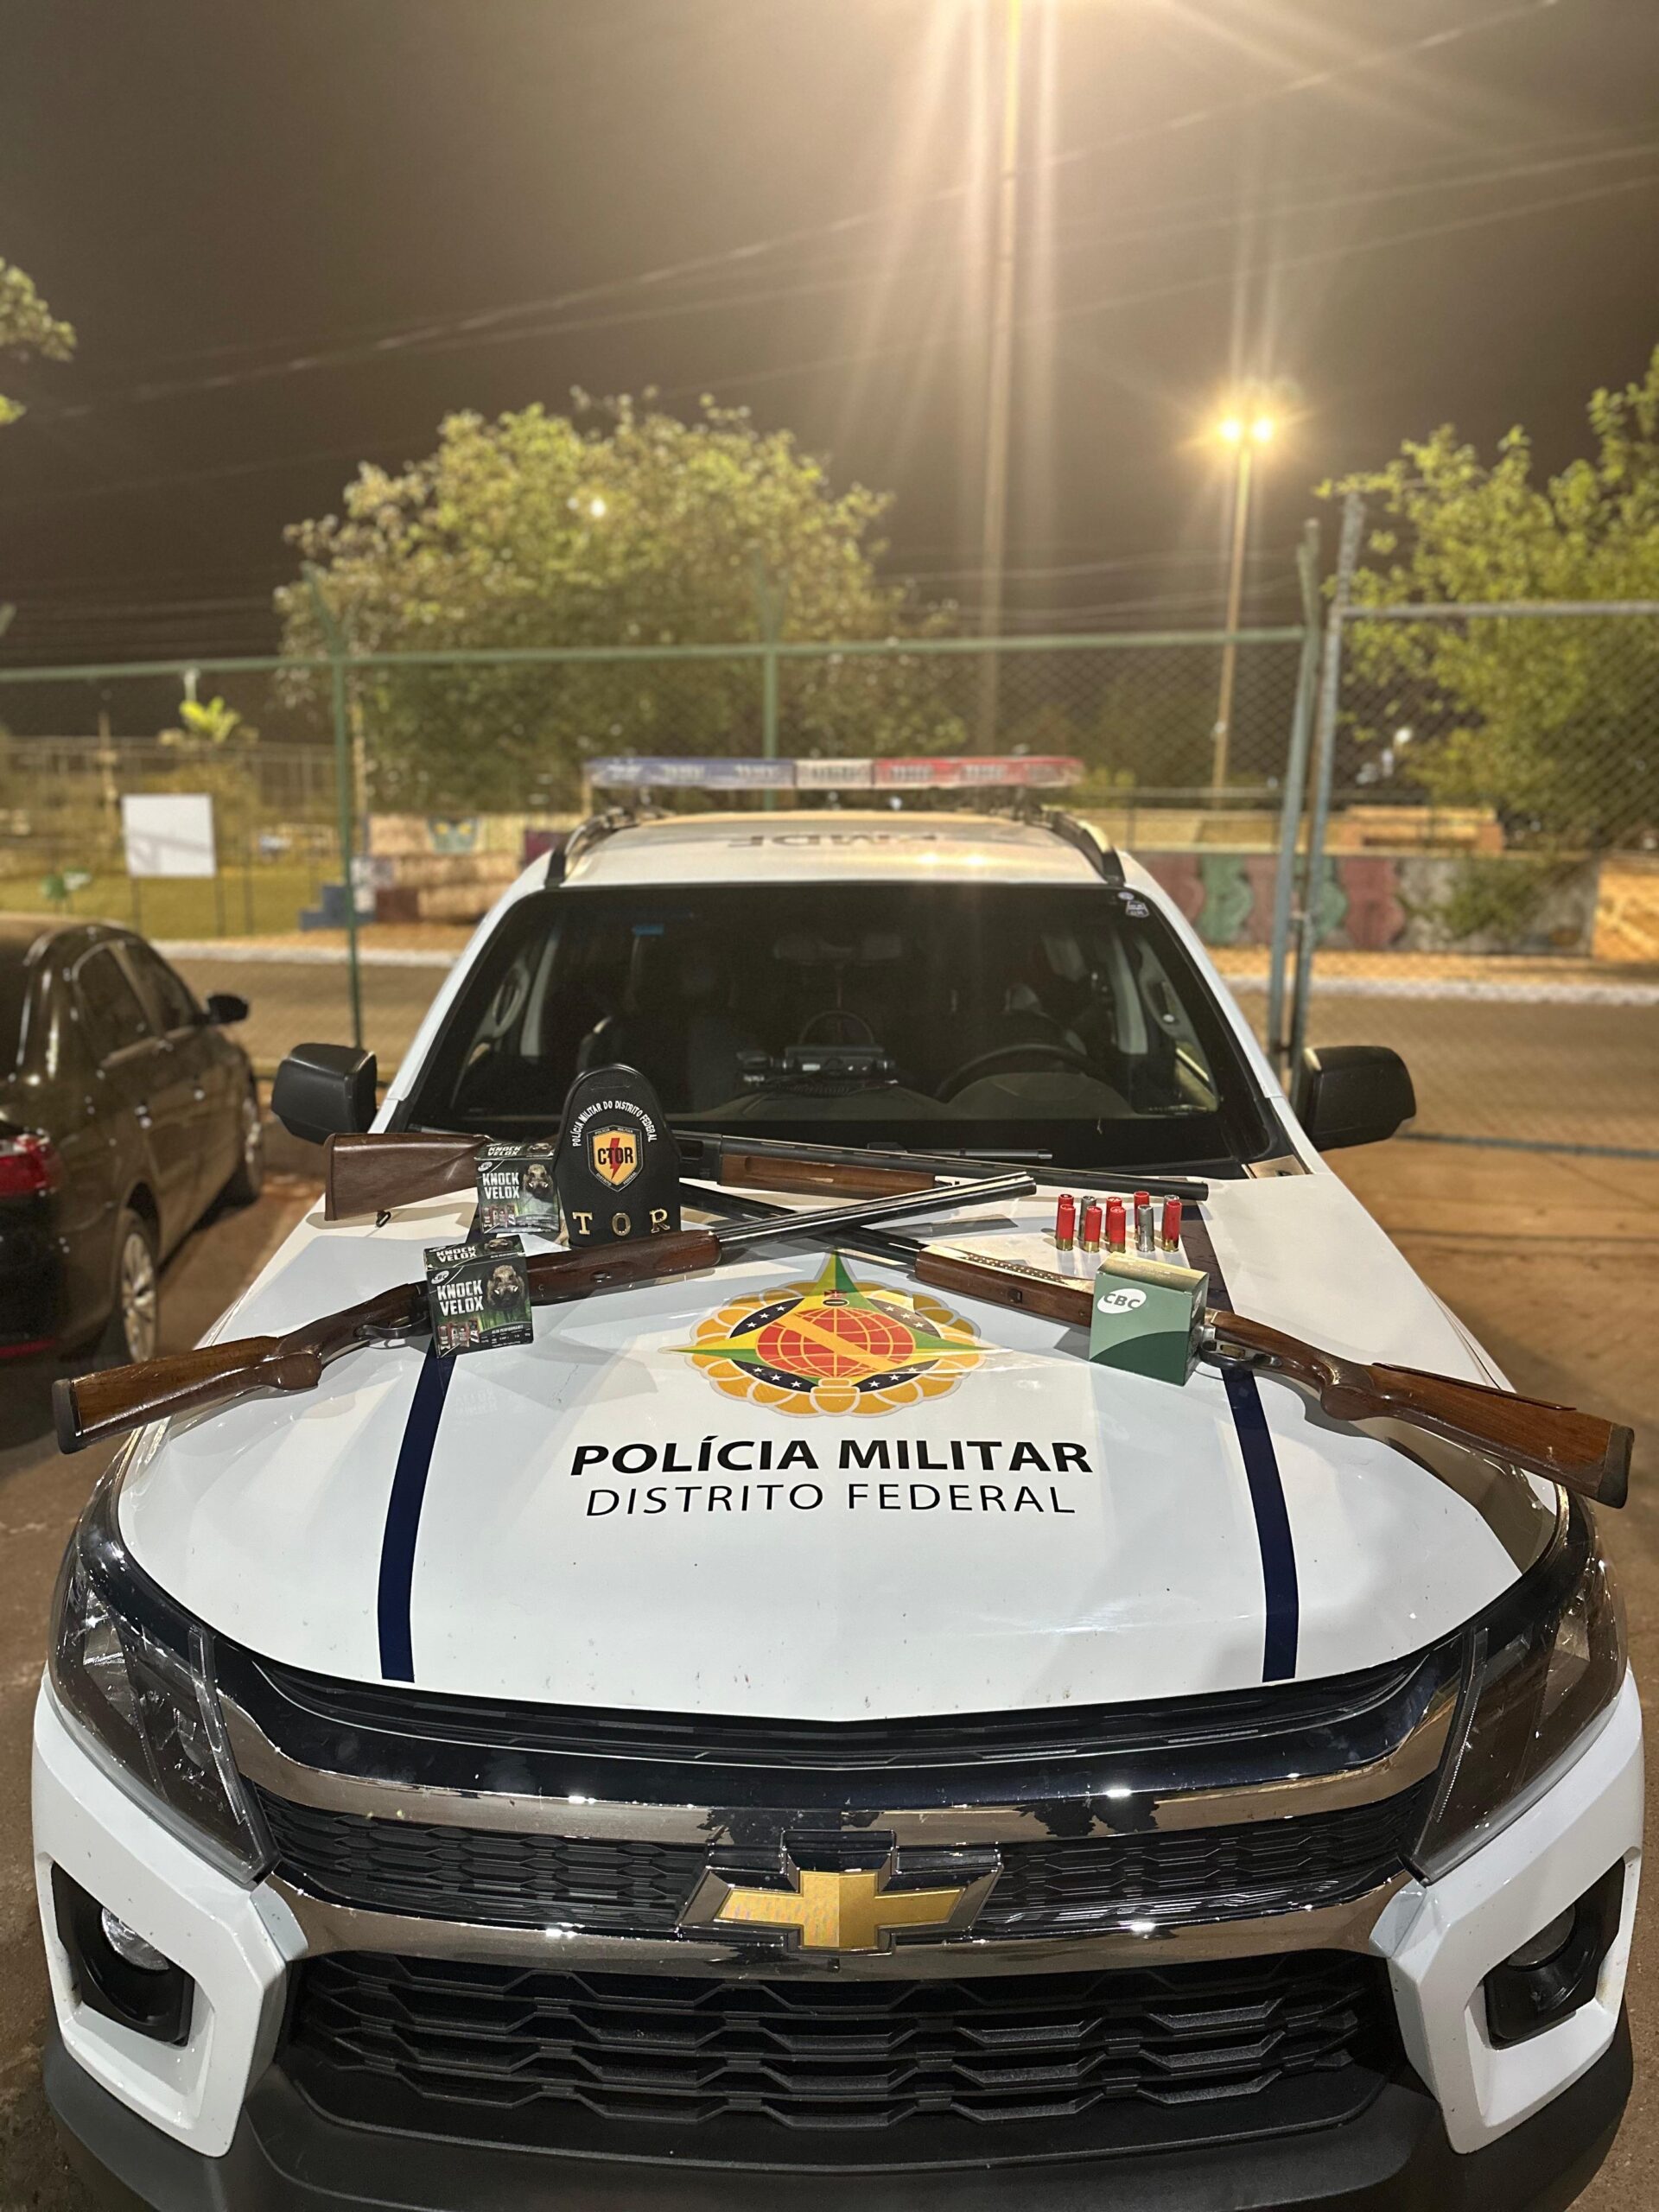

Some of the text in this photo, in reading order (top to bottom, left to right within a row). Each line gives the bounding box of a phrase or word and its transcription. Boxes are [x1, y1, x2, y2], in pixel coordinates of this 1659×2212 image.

[570, 1100, 658, 1147] POLÍCIA MILITAR DO DISTRITO FEDERAL
[597, 1147, 634, 1165] CTOR
[482, 1172, 520, 1186] KNOCK
[484, 1185, 520, 1199] VELOX
[436, 1245, 476, 1256] KNOCK
[438, 1251, 477, 1262] VELOX
[436, 1280, 484, 1300] KNOCK
[439, 1295, 485, 1317] VELOX
[1103, 1293, 1141, 1310] CBC
[570, 1435, 1093, 1476] POLÍCIA MILITAR
[586, 1484, 1076, 1516] DISTRITO FEDERAL
